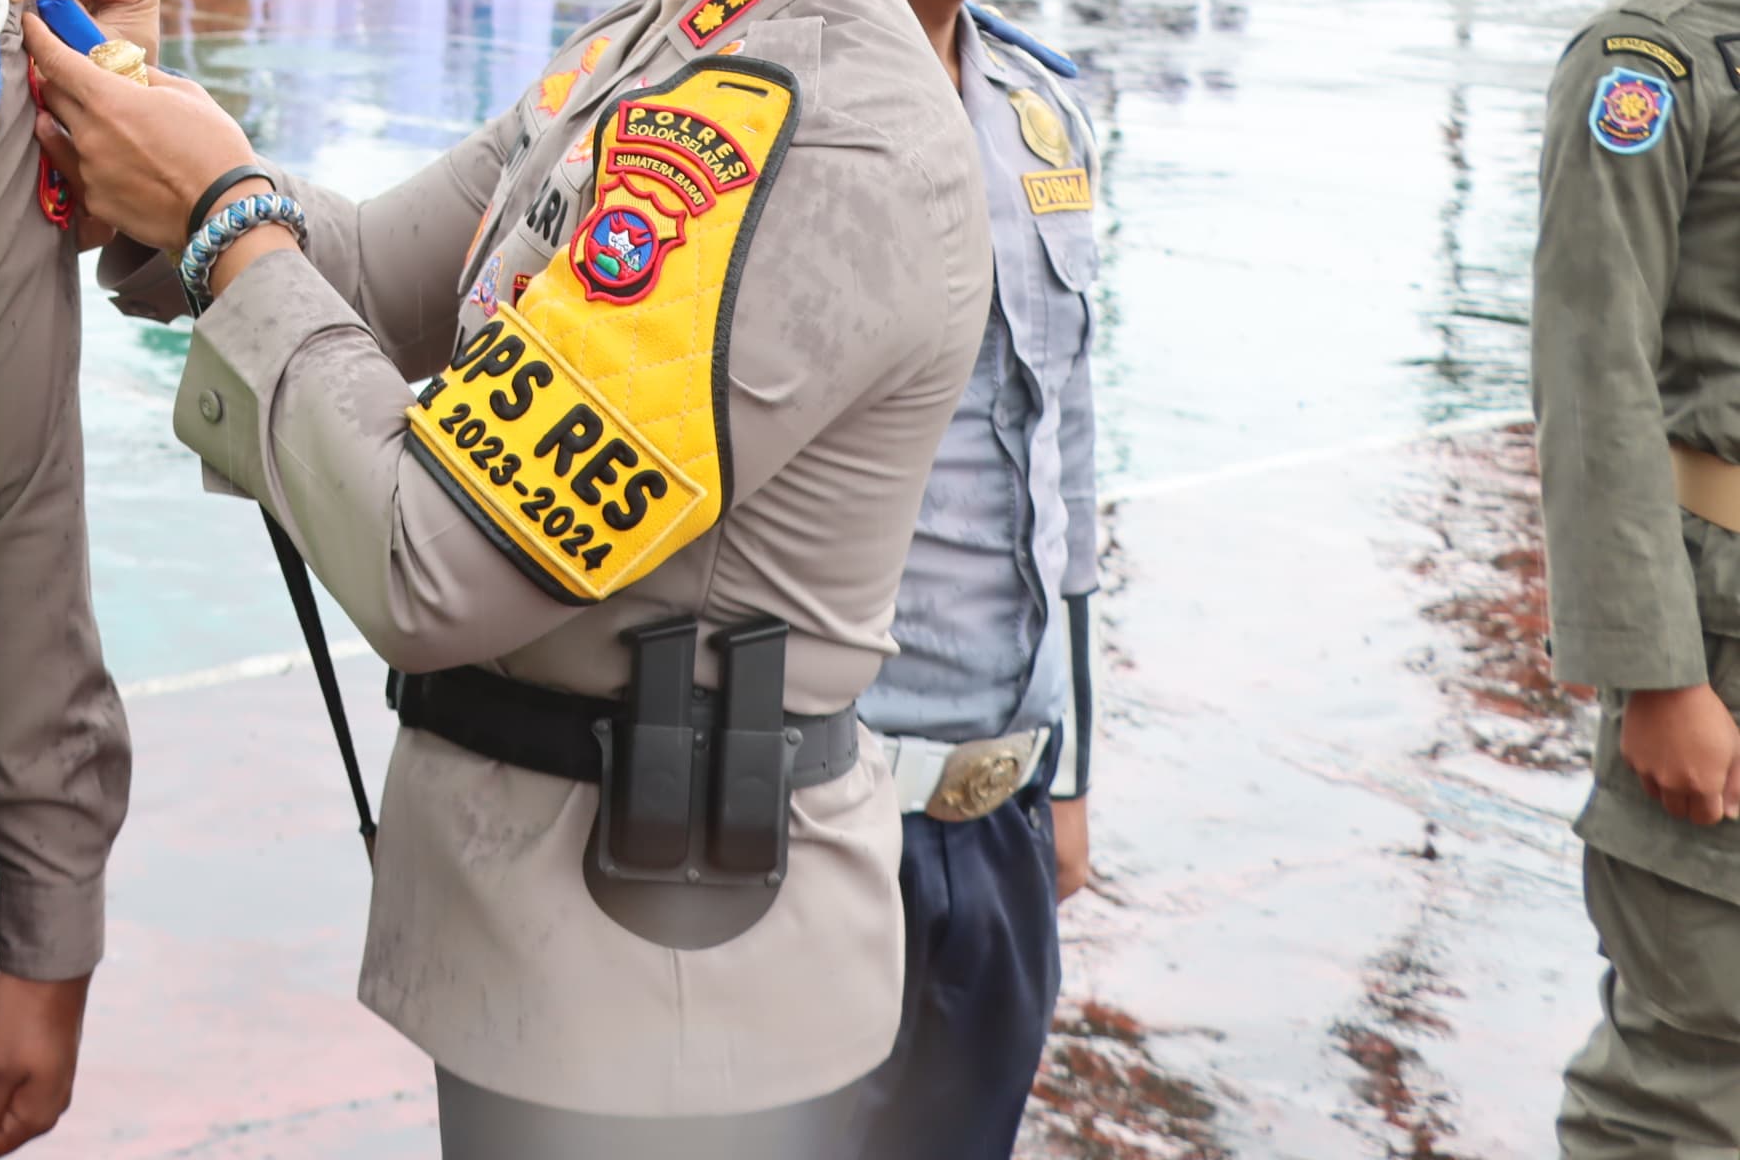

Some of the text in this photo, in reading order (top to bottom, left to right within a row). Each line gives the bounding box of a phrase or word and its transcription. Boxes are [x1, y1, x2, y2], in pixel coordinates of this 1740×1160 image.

[626, 123, 732, 184] SOLOK SELATAN
[628, 107, 747, 178] POLRES
[615, 153, 707, 206] SUMATERA BARAT
[451, 321, 669, 530] OPS RES
[438, 402, 613, 571] 2023-2024
